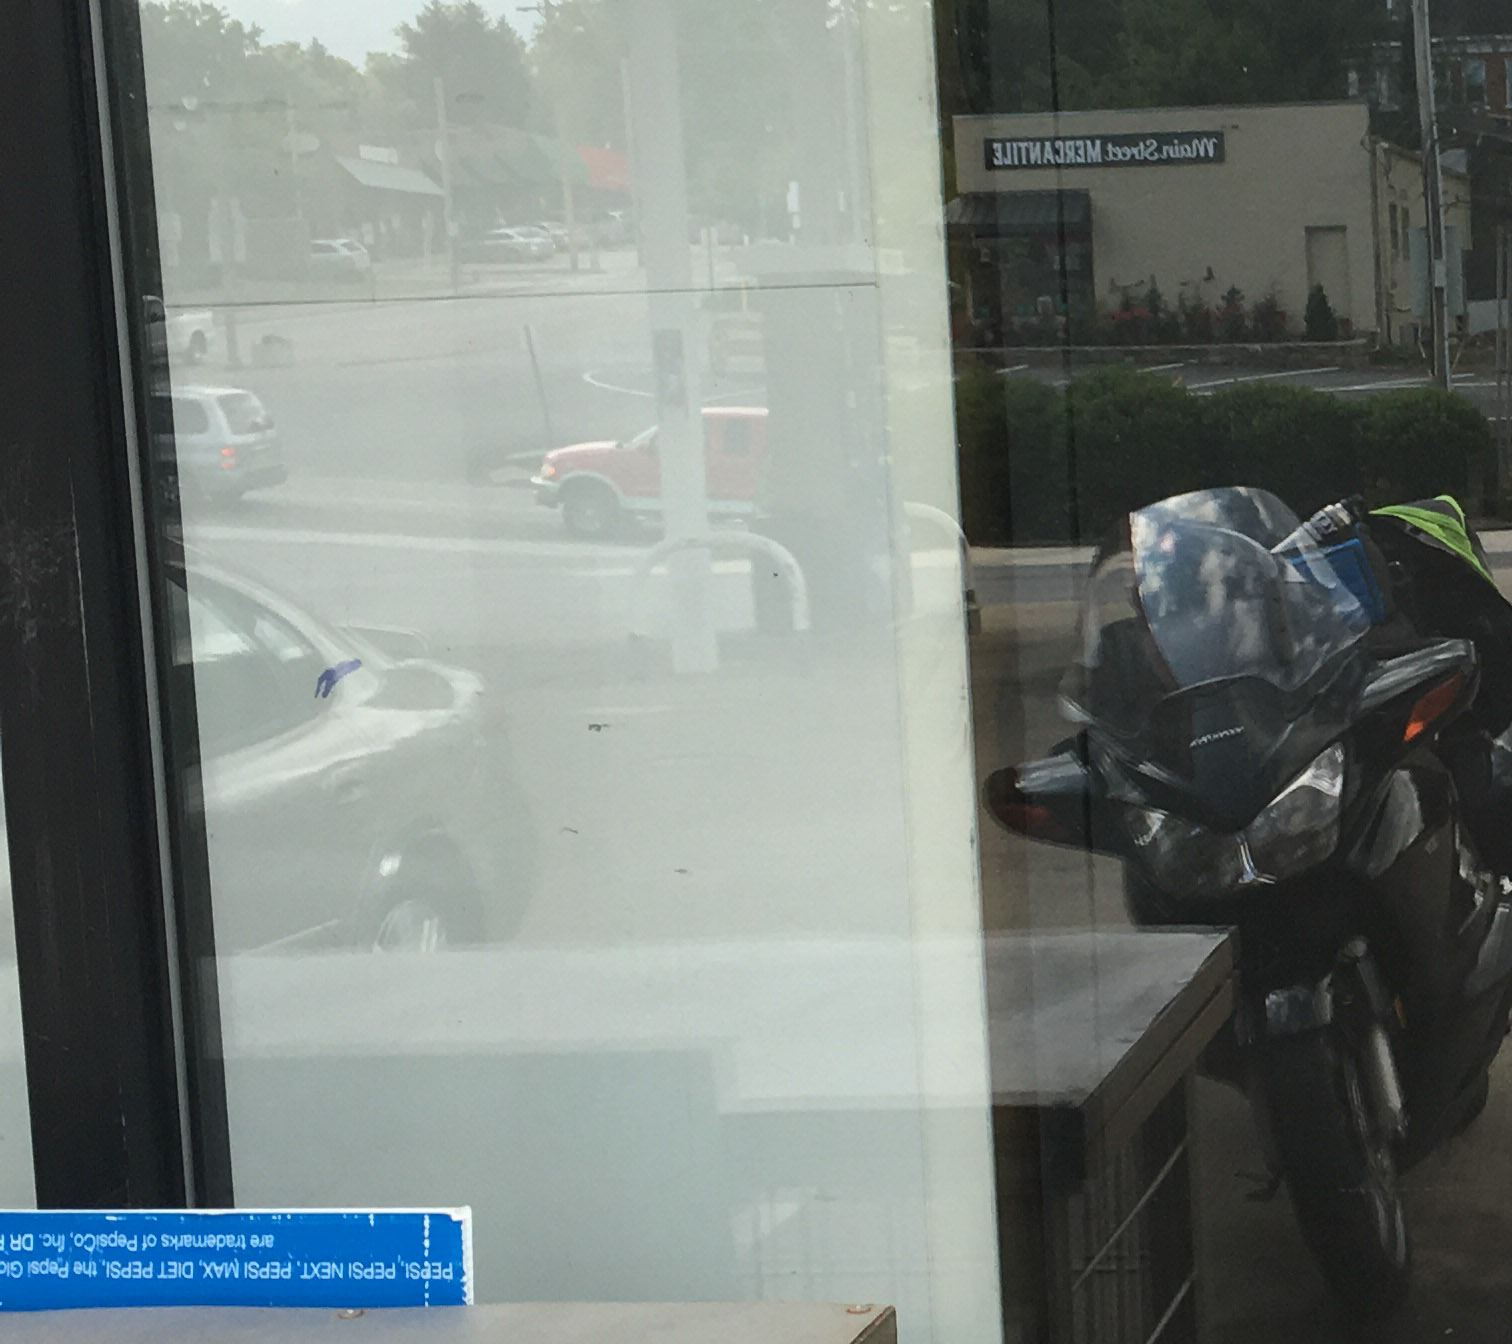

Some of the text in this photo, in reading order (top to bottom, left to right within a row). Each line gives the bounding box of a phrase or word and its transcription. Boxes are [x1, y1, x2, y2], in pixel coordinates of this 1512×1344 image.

[9, 1233, 35, 1252] DR
[69, 1231, 138, 1253] PepsiCo,
[142, 1233, 157, 1251] of
[160, 1232, 247, 1251] trademarks
[249, 1233, 275, 1248] are
[27, 1258, 69, 1279] Pepsi
[73, 1260, 98, 1278] the
[101, 1259, 154, 1279] PEPSI,
[156, 1260, 194, 1279] DIET
[198, 1259, 240, 1280] MAX,
[244, 1261, 292, 1280] PEPSI
[297, 1260, 344, 1280] NEXT,
[348, 1262, 396, 1280] PEPSI
[399, 1261, 453, 1281] PEPSI,
